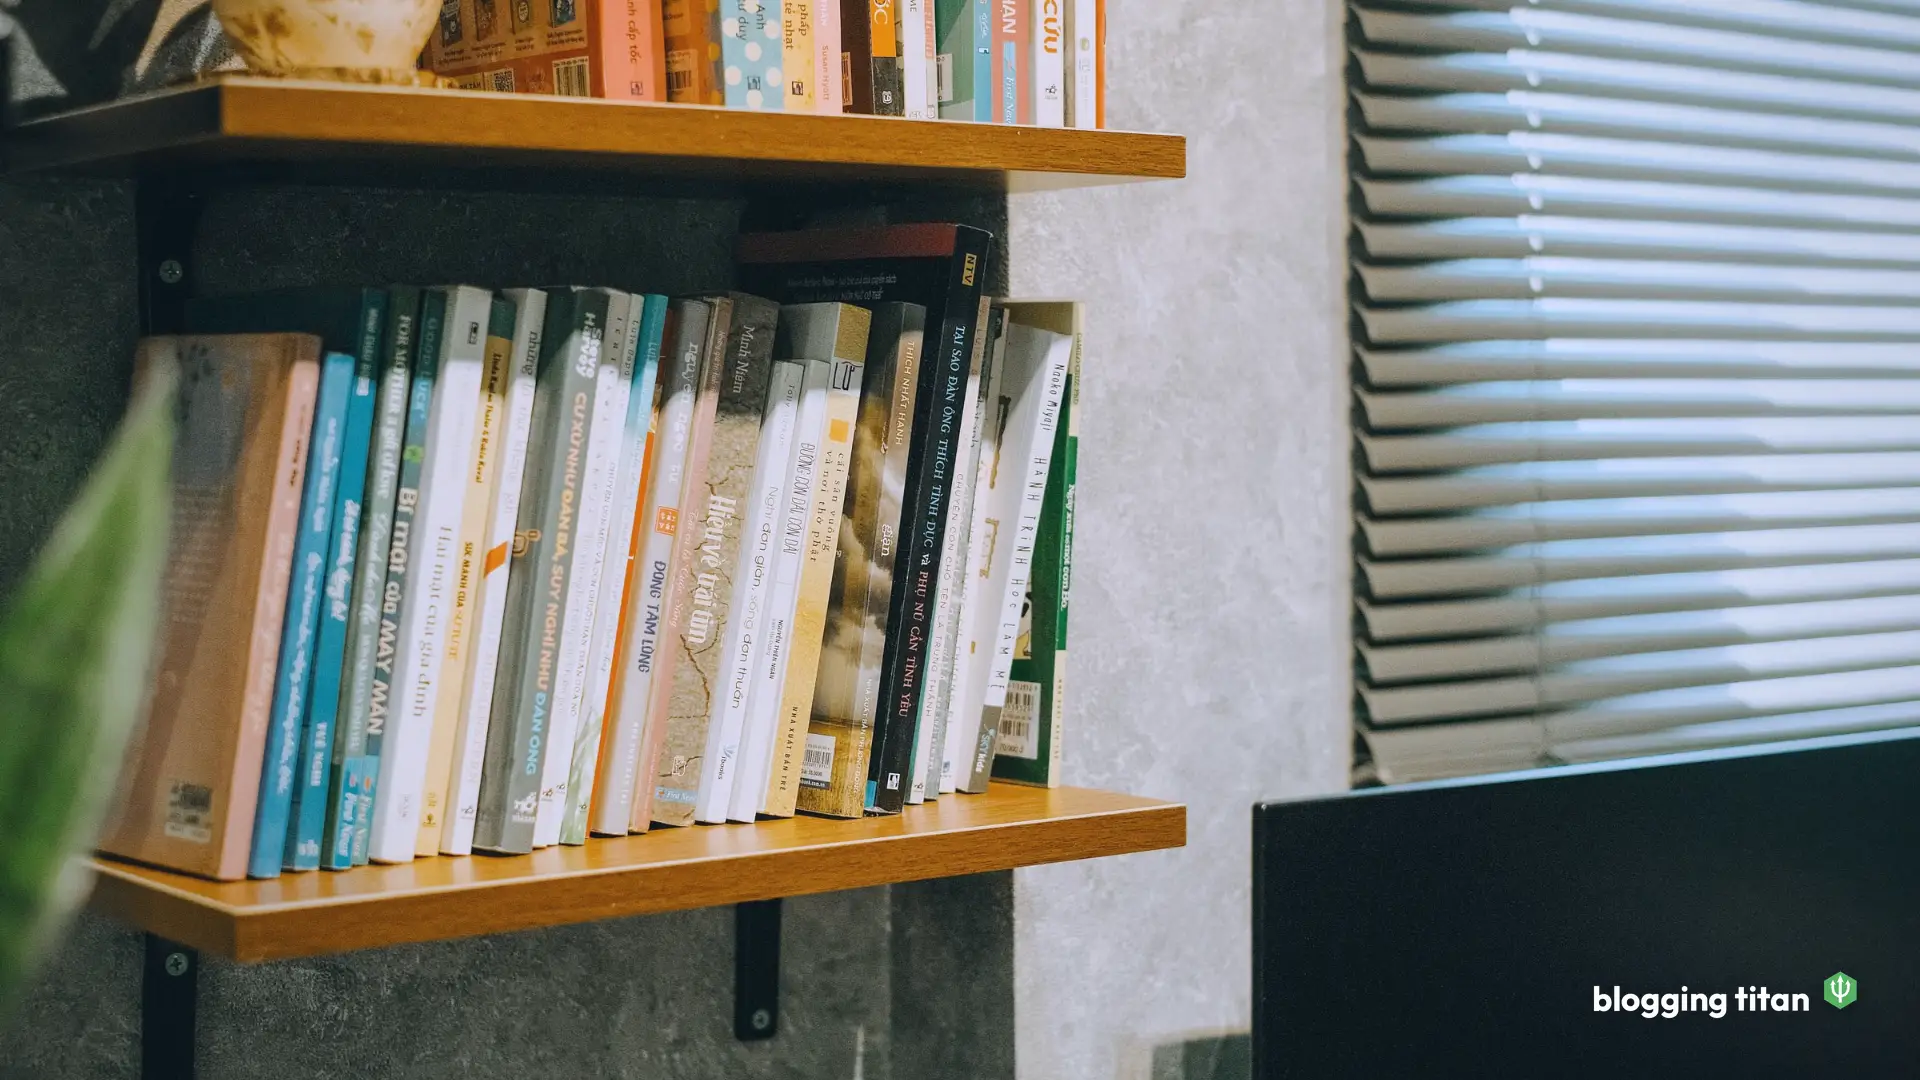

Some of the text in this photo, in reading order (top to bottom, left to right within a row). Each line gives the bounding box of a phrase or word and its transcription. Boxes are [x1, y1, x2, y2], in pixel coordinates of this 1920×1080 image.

[736, 16, 750, 41] duy
[756, 4, 766, 30] Anh
[798, 3, 810, 37] pháp
[630, 45, 642, 64] tốc
[964, 255, 976, 284] NTV
[573, 311, 595, 378] Harvey
[584, 327, 602, 379] Steve
[738, 324, 755, 358] Minh
[903, 341, 915, 374] THÍCH
[898, 377, 912, 409] NHẤT
[1039, 363, 1064, 432] Naoko Miyaji
[824, 450, 834, 464] và
[820, 471, 830, 493] nơi
[1026, 456, 1048, 501] HÀNH
[814, 501, 826, 525] thờ
[821, 452, 846, 552] cái sân vuông
[897, 325, 964, 717] TẠI SAO ĐÀN ÔNG THÍCH TÌNH DỤC và PHỤ NỮ CẦN TÌNH YÊU
[878, 524, 894, 557] giận
[946, 526, 956, 551] CON
[547, 564, 564, 600] SUY
[685, 493, 736, 645] Hiểu về trái tim
[374, 618, 397, 673] MAY
[930, 636, 942, 673] TRUNG
[999, 621, 1017, 656] LÀM
